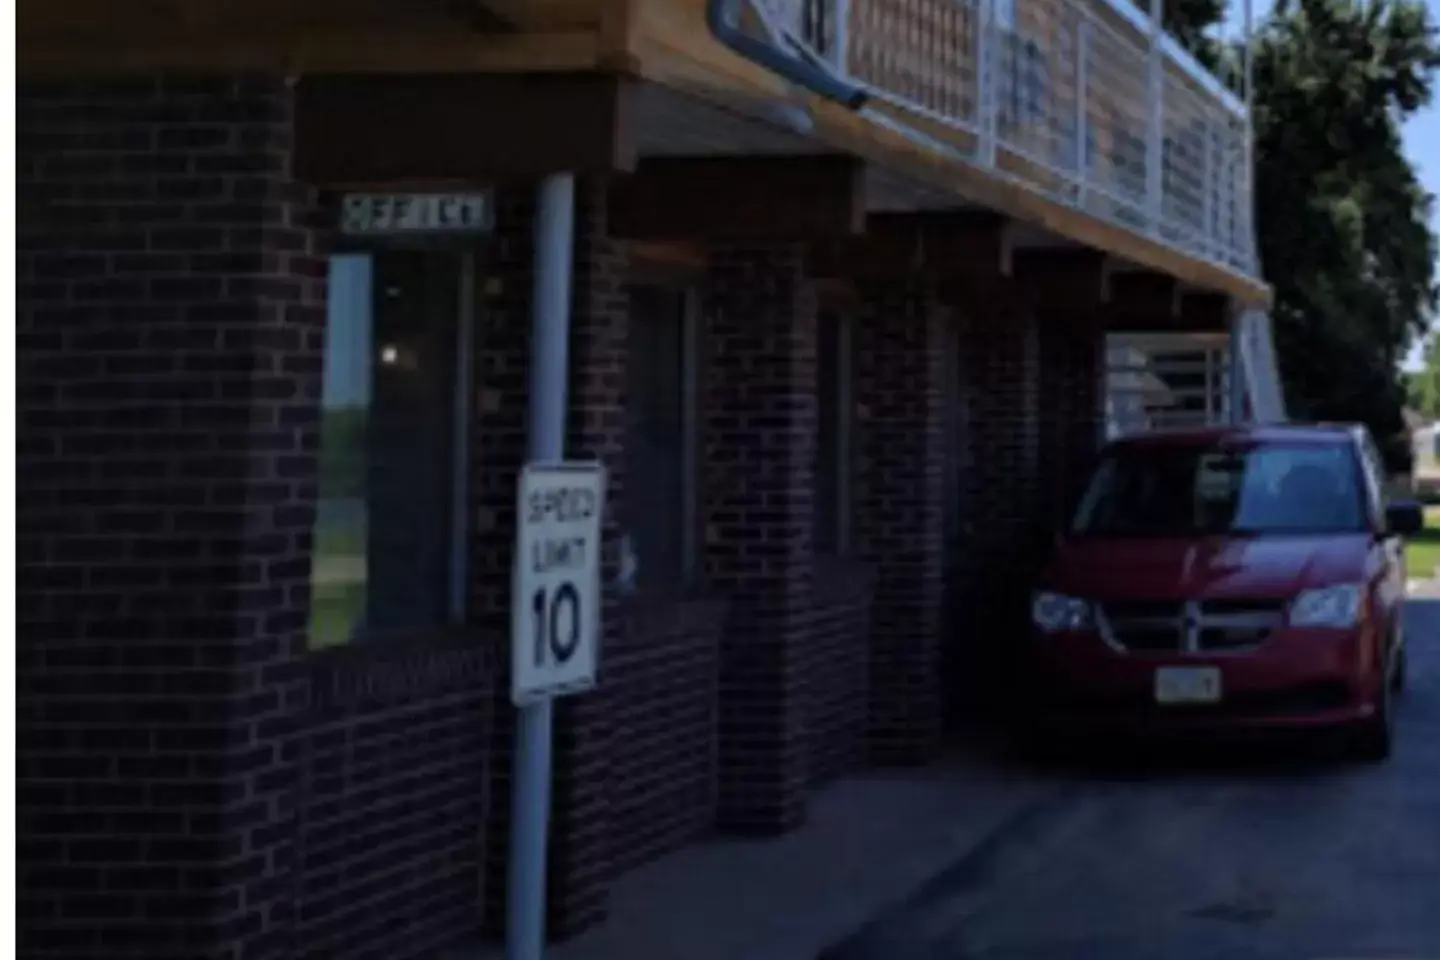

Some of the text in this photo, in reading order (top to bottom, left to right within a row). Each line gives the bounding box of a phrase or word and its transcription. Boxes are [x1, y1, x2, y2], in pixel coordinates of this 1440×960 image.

[526, 487, 595, 522] SPEED
[532, 537, 586, 573] LIMIT
[532, 581, 581, 667] 10
